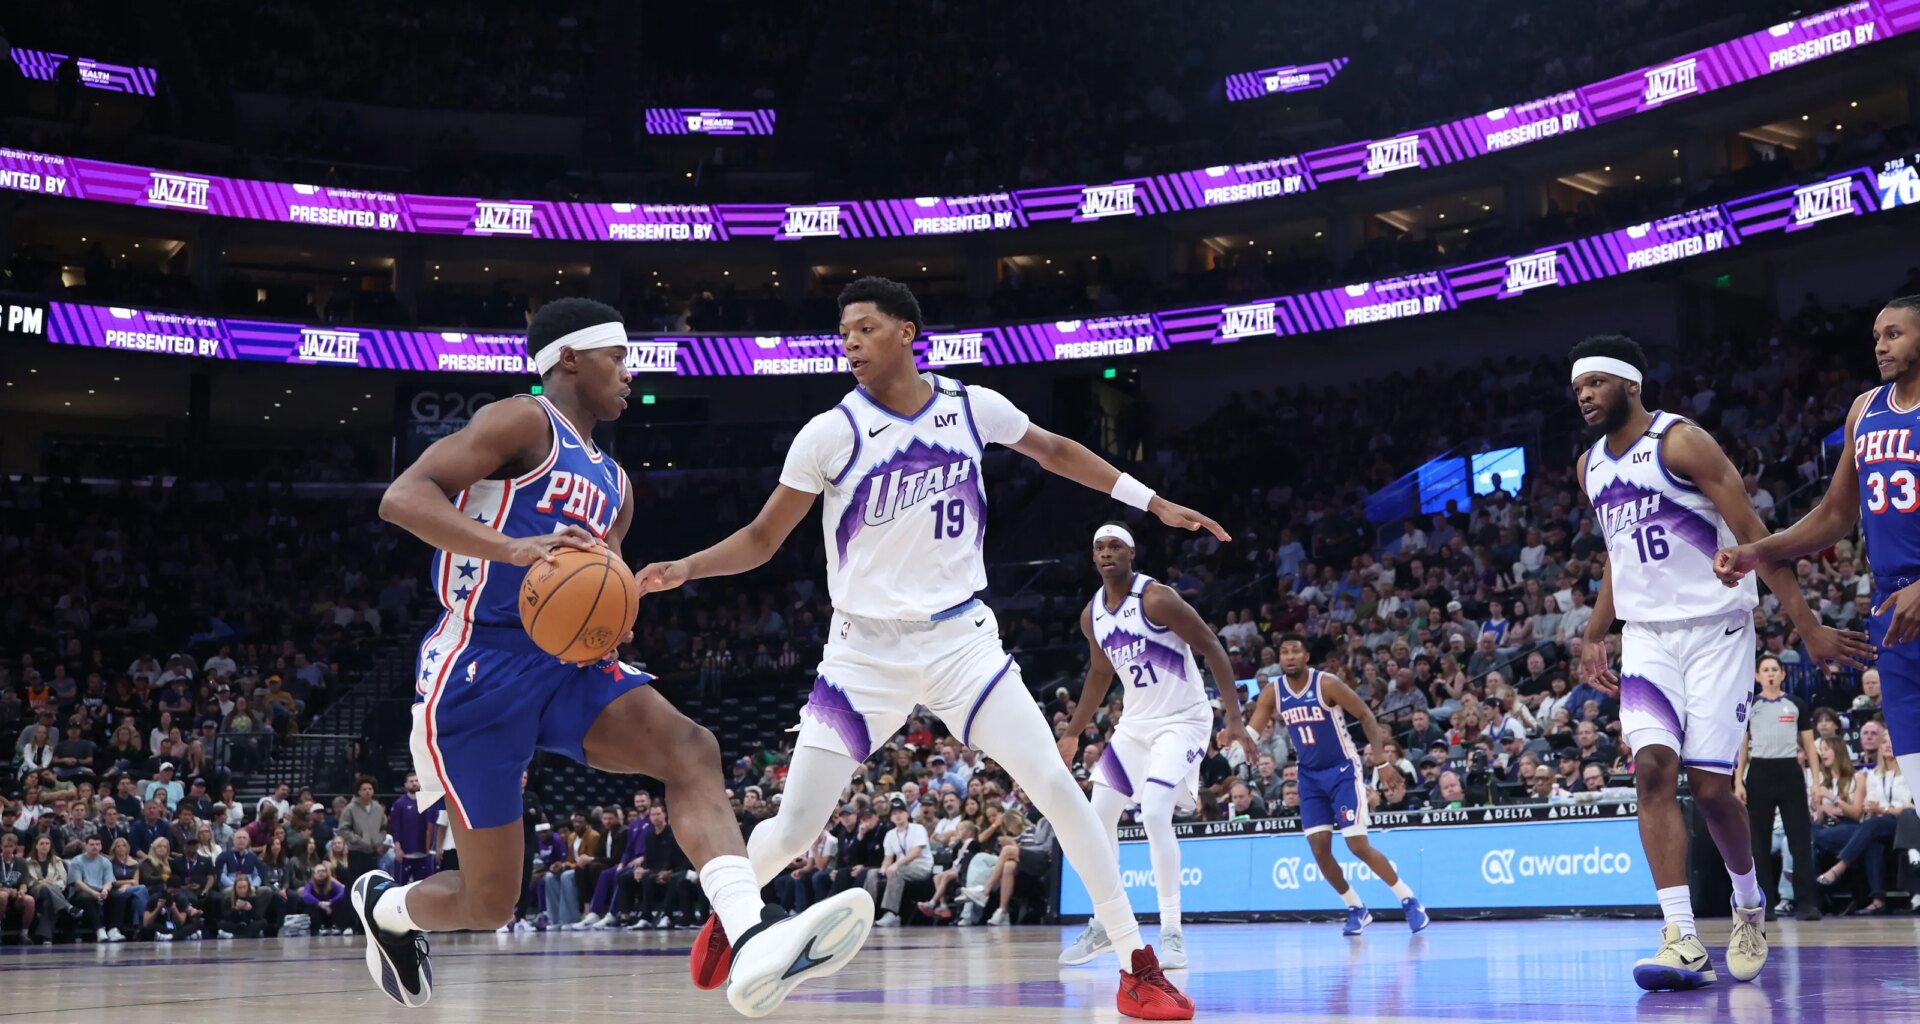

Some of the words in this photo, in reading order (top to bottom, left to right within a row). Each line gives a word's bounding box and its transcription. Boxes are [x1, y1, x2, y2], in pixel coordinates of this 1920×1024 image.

[1769, 30, 1850, 70] PRESENTED
[1854, 22, 1875, 44] BY
[1486, 118, 1559, 150] PRESENTED
[1562, 111, 1580, 131] BY
[44, 156, 64, 166] UTAH
[46, 176, 66, 194] BY
[327, 190, 366, 200] UNIVERSITY
[378, 194, 396, 202] UTAH
[1204, 181, 1280, 204] PRESENTED
[1284, 175, 1302, 193] BY
[290, 206, 374, 227] PRESENTED
[380, 213, 398, 229] BY
[914, 215, 990, 233] PRESENTED
[994, 212, 1012, 228] BY
[610, 224, 690, 239] PRESENTED
[694, 224, 712, 239] BY
[1627, 236, 1702, 270] PRESENTED
[1706, 230, 1724, 250] BY
[8, 304, 42, 334] PM
[146, 314, 186, 326] UNIVERSITY
[187, 318, 196, 326] OF
[198, 319, 217, 327] UTAH
[1345, 298, 1420, 326] PRESENTED
[1424, 294, 1442, 313] BY
[106, 330, 194, 354] PRESENTED
[199, 339, 220, 356] BY
[1055, 338, 1132, 360] PRESENTED
[1136, 336, 1154, 352] BY
[438, 354, 522, 372] PRESENTED
[754, 358, 833, 374] PRESENTED
[934, 413, 958, 428] LVT
[1632, 451, 1652, 464] LVT
[864, 457, 973, 526] UTAH
[1866, 470, 1920, 514] 33
[930, 500, 964, 540] 19
[1631, 525, 1670, 564] 16
[1129, 660, 1158, 688] 21
[1280, 706, 1326, 726] PHILA
[1298, 726, 1316, 745] 11
[1118, 828, 1146, 838] DELTA
[1212, 822, 1244, 833] DELTA
[1264, 820, 1296, 830] DELTA
[1374, 814, 1408, 825] DELTA
[1433, 811, 1468, 822] DELTA
[1495, 808, 1532, 819] DELTA
[1560, 805, 1599, 816] DELTA
[1519, 846, 1631, 876] awardco
